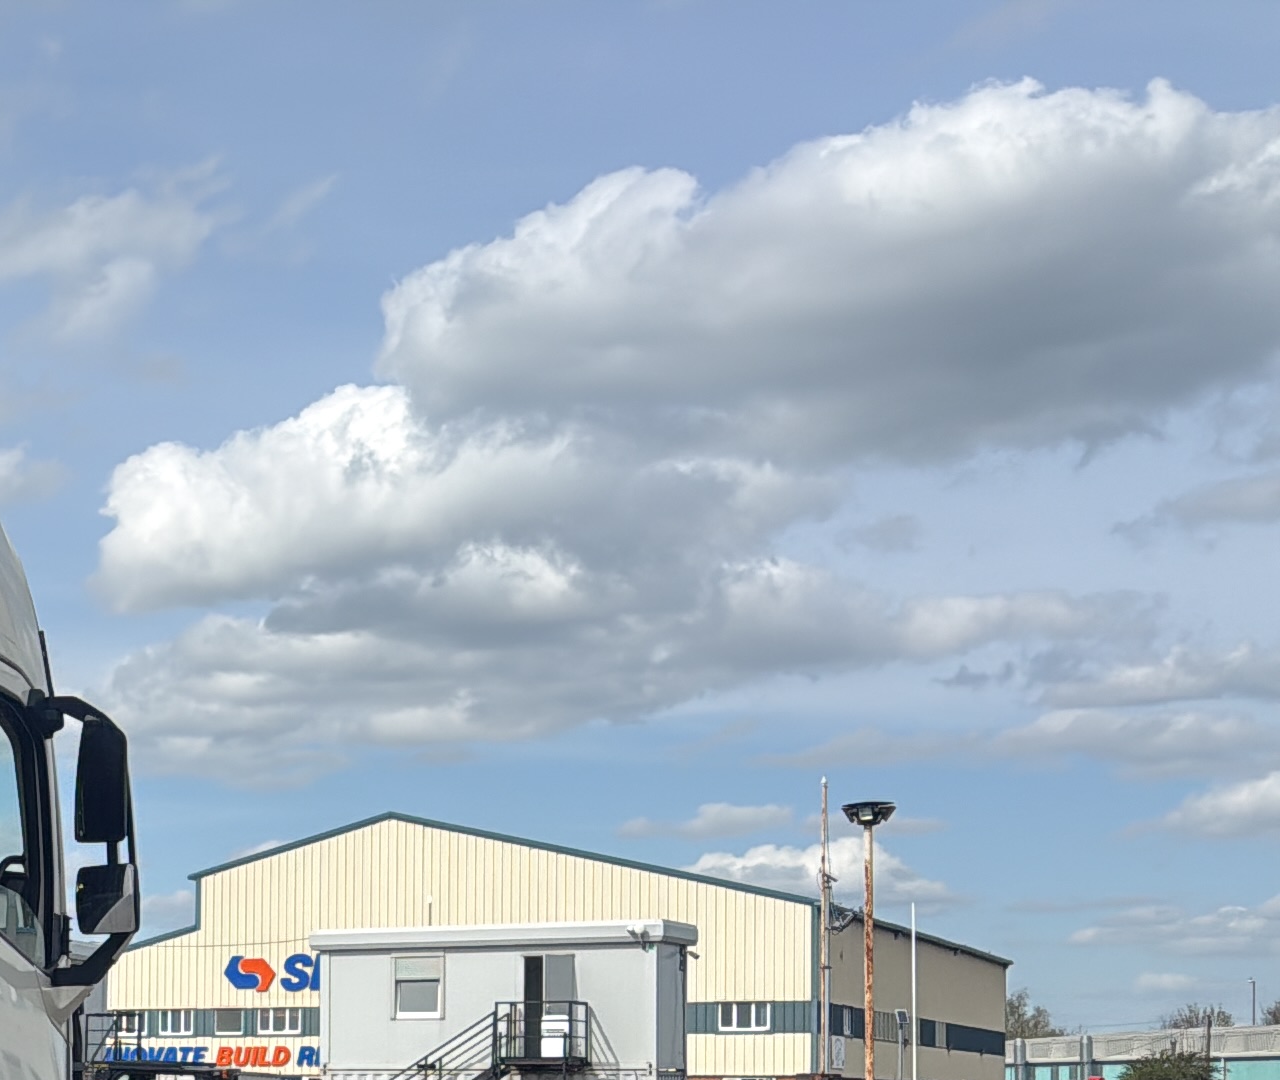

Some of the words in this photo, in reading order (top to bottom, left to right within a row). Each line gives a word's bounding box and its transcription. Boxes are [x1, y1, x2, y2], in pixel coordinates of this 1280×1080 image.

[280, 953, 320, 992] S
[105, 1047, 209, 1064] OVATE
[216, 1046, 290, 1067] BUILD
